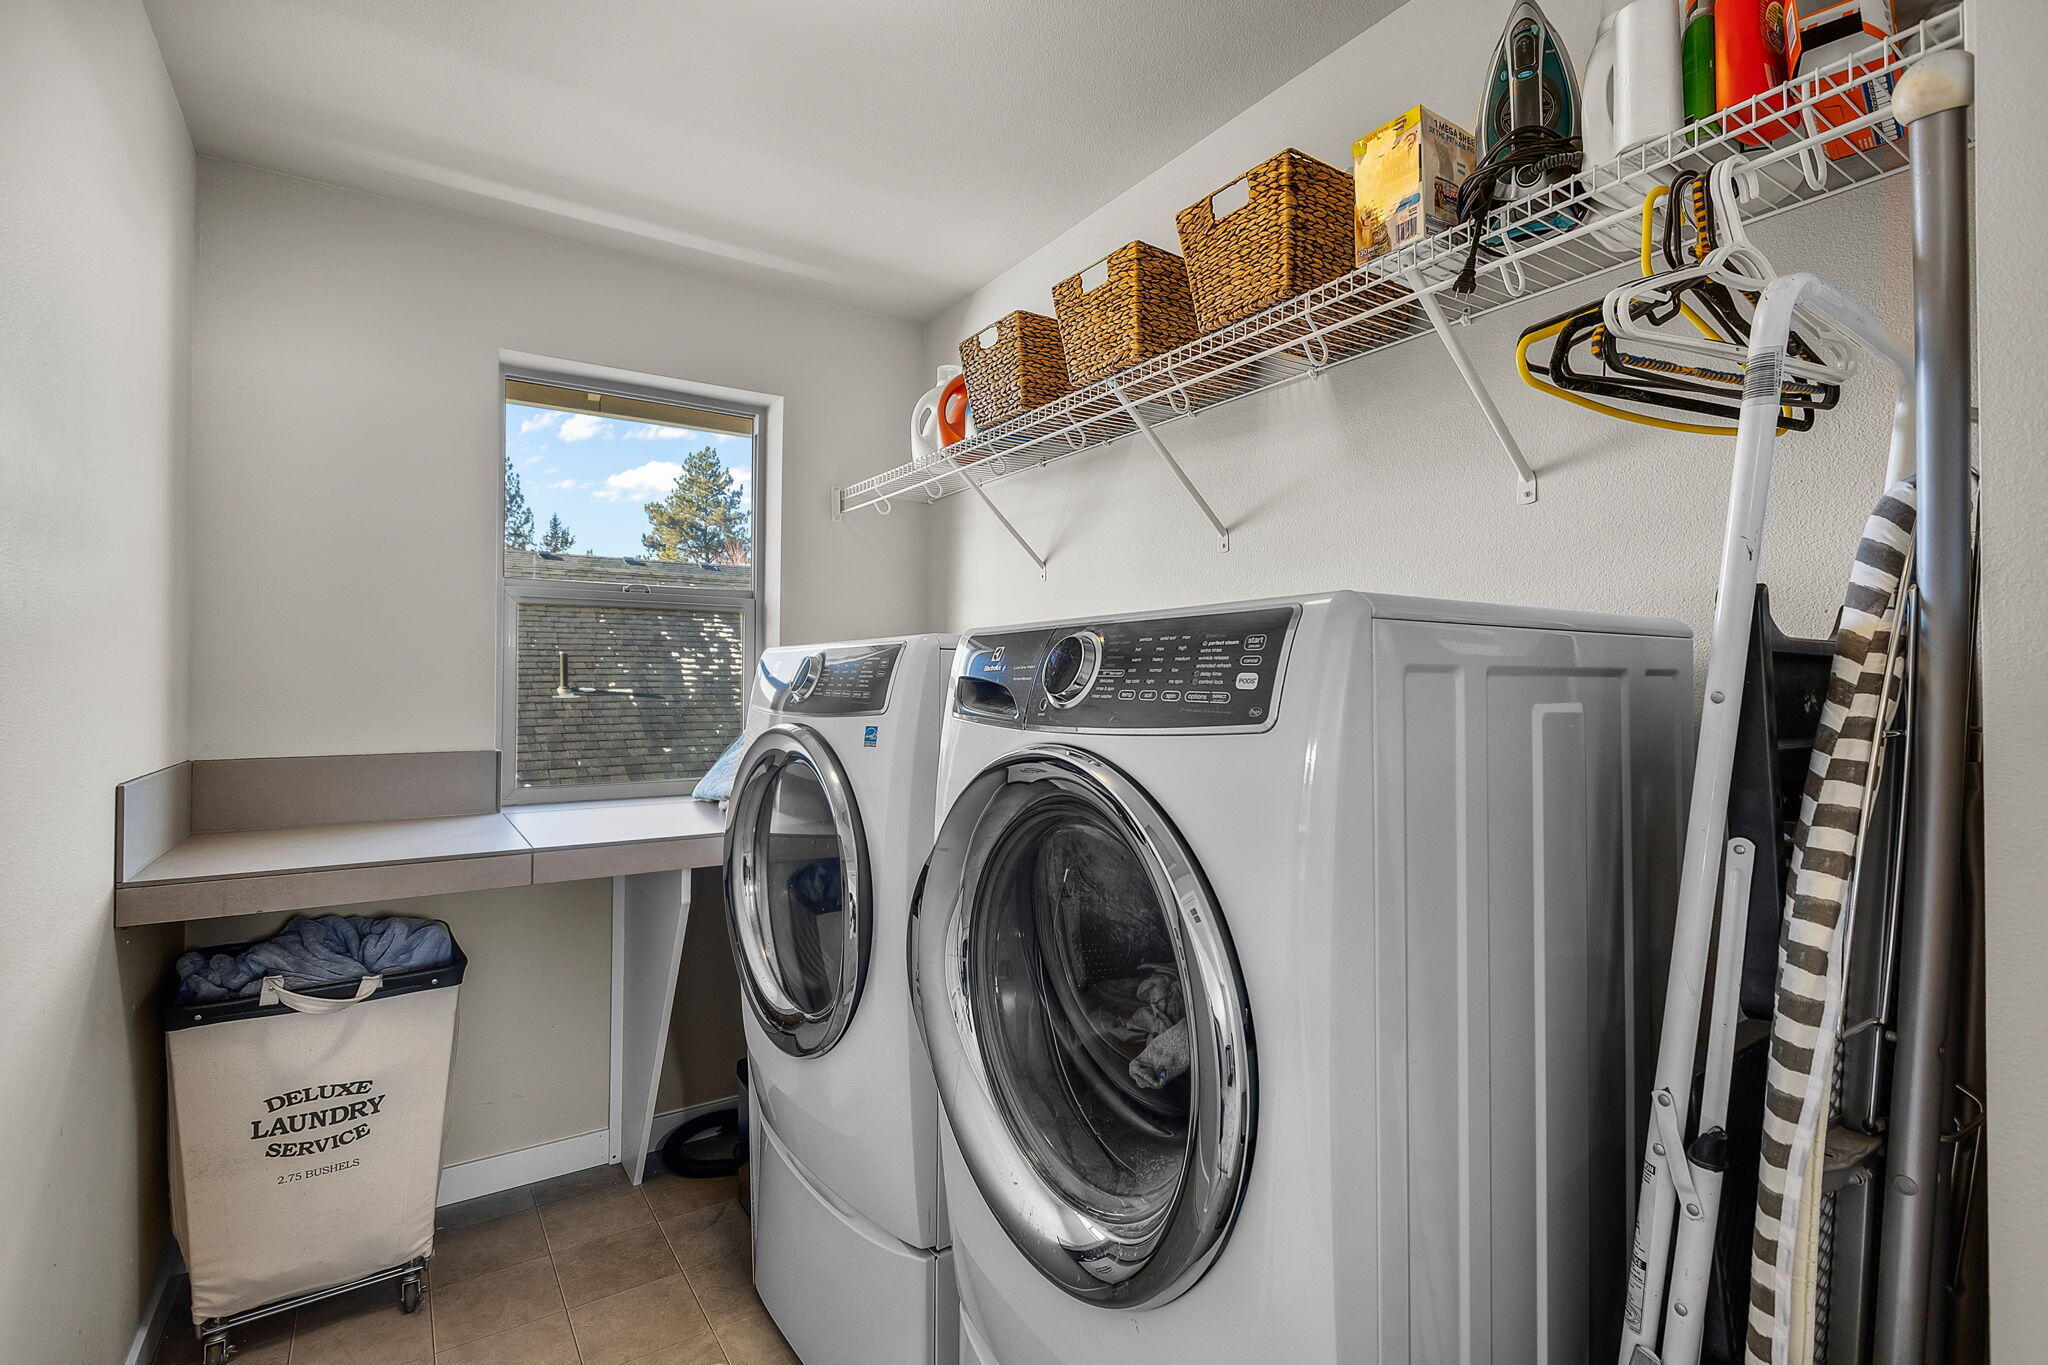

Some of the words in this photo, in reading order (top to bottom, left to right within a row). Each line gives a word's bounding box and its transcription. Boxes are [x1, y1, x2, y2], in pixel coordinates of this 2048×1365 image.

[1438, 121, 1458, 138] MEGA
[1458, 131, 1476, 147] SHEE
[263, 1080, 373, 1113] DELUXE
[251, 1094, 386, 1140] LAUNDRY
[265, 1123, 371, 1158] SERVICE
[277, 1172, 302, 1185] 2.75
[305, 1158, 360, 1179] BUSHELS
